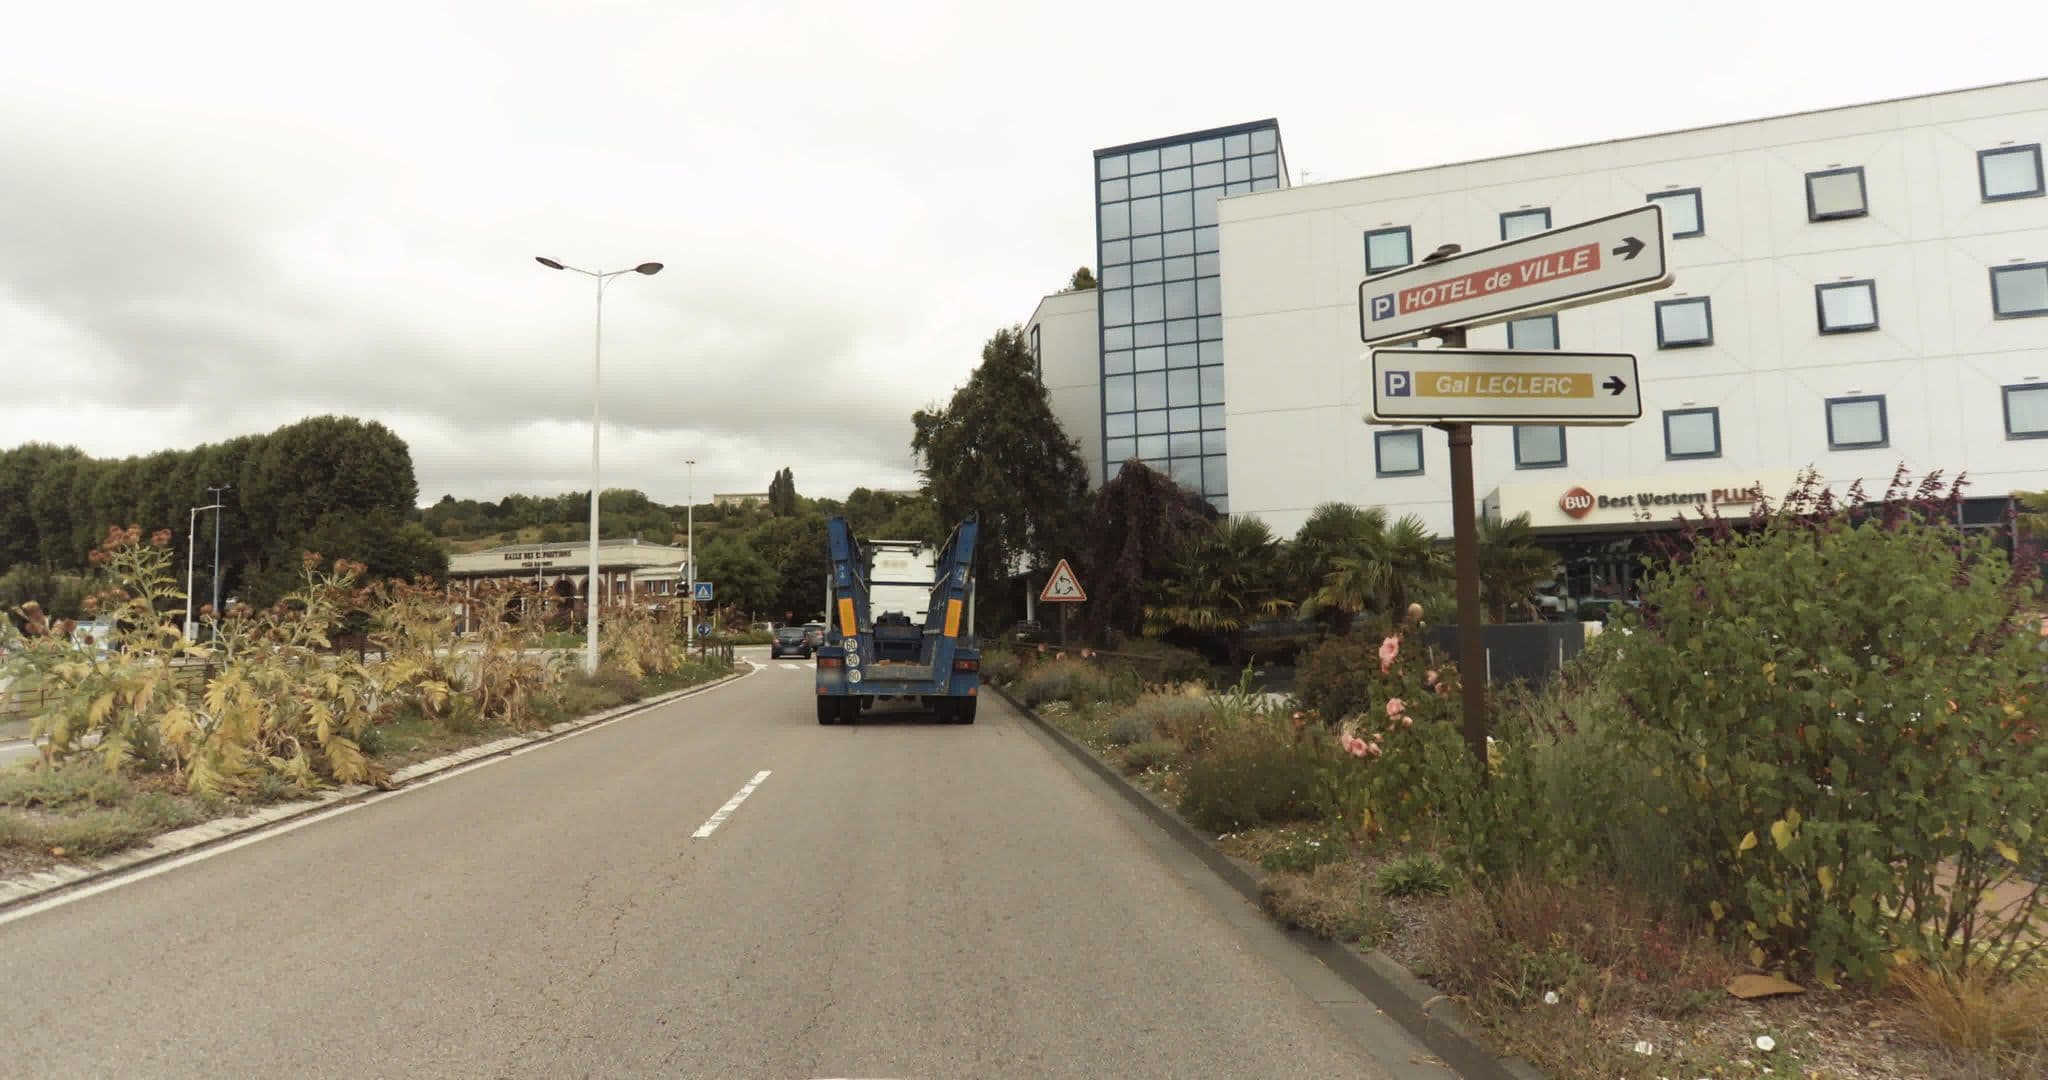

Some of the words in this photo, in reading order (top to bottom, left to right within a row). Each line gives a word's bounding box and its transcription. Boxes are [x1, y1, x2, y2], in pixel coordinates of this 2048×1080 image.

[1374, 298, 1392, 320] P
[1404, 279, 1478, 311] HOTEL
[1484, 271, 1513, 291] de
[1519, 249, 1592, 284] VILLE
[1389, 374, 1406, 394] P
[1436, 375, 1469, 394] Gal
[1475, 375, 1573, 395] LECLERC
[1564, 494, 1592, 511] BW
[1598, 494, 1634, 508] Best
[1637, 491, 1708, 507] Western
[1711, 487, 1756, 504] PLUS
